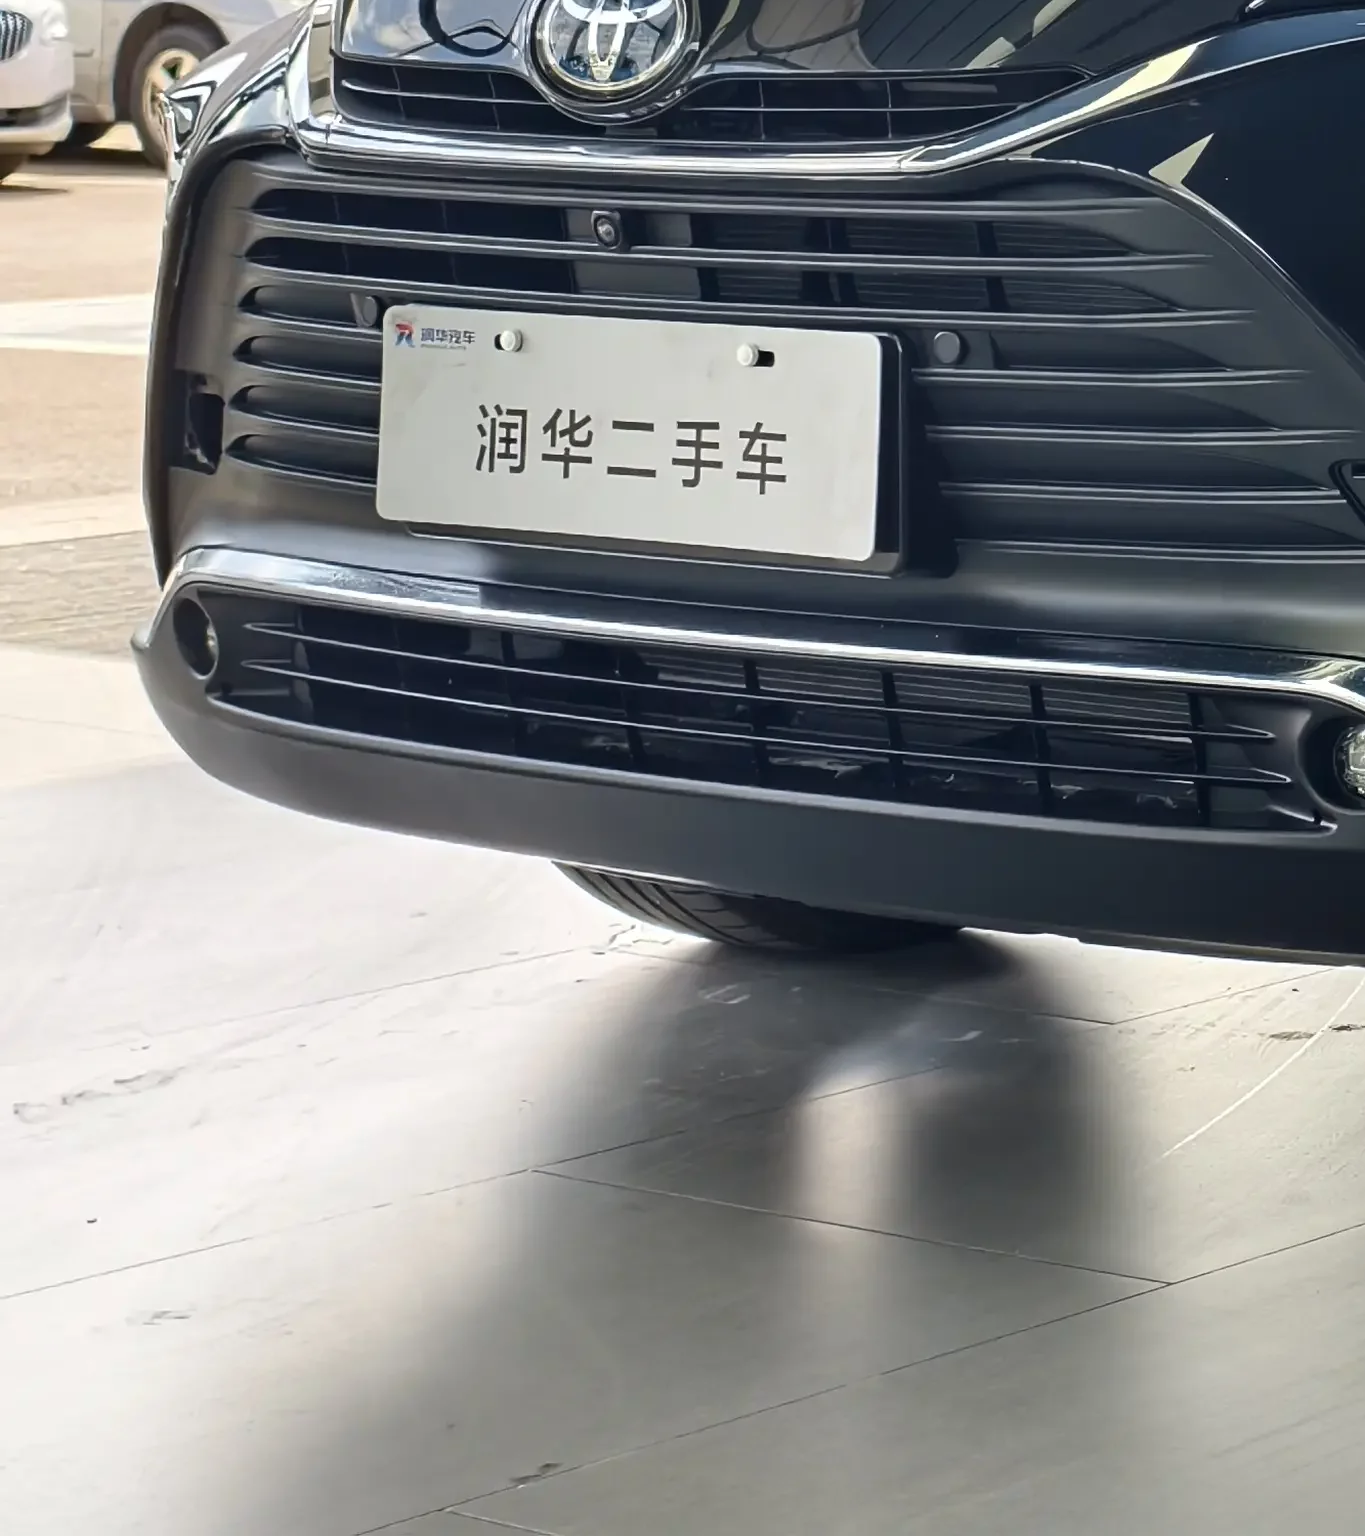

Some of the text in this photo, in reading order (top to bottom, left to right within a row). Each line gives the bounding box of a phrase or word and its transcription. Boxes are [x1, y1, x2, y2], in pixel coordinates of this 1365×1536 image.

[474, 402, 788, 496] 润华二手车
